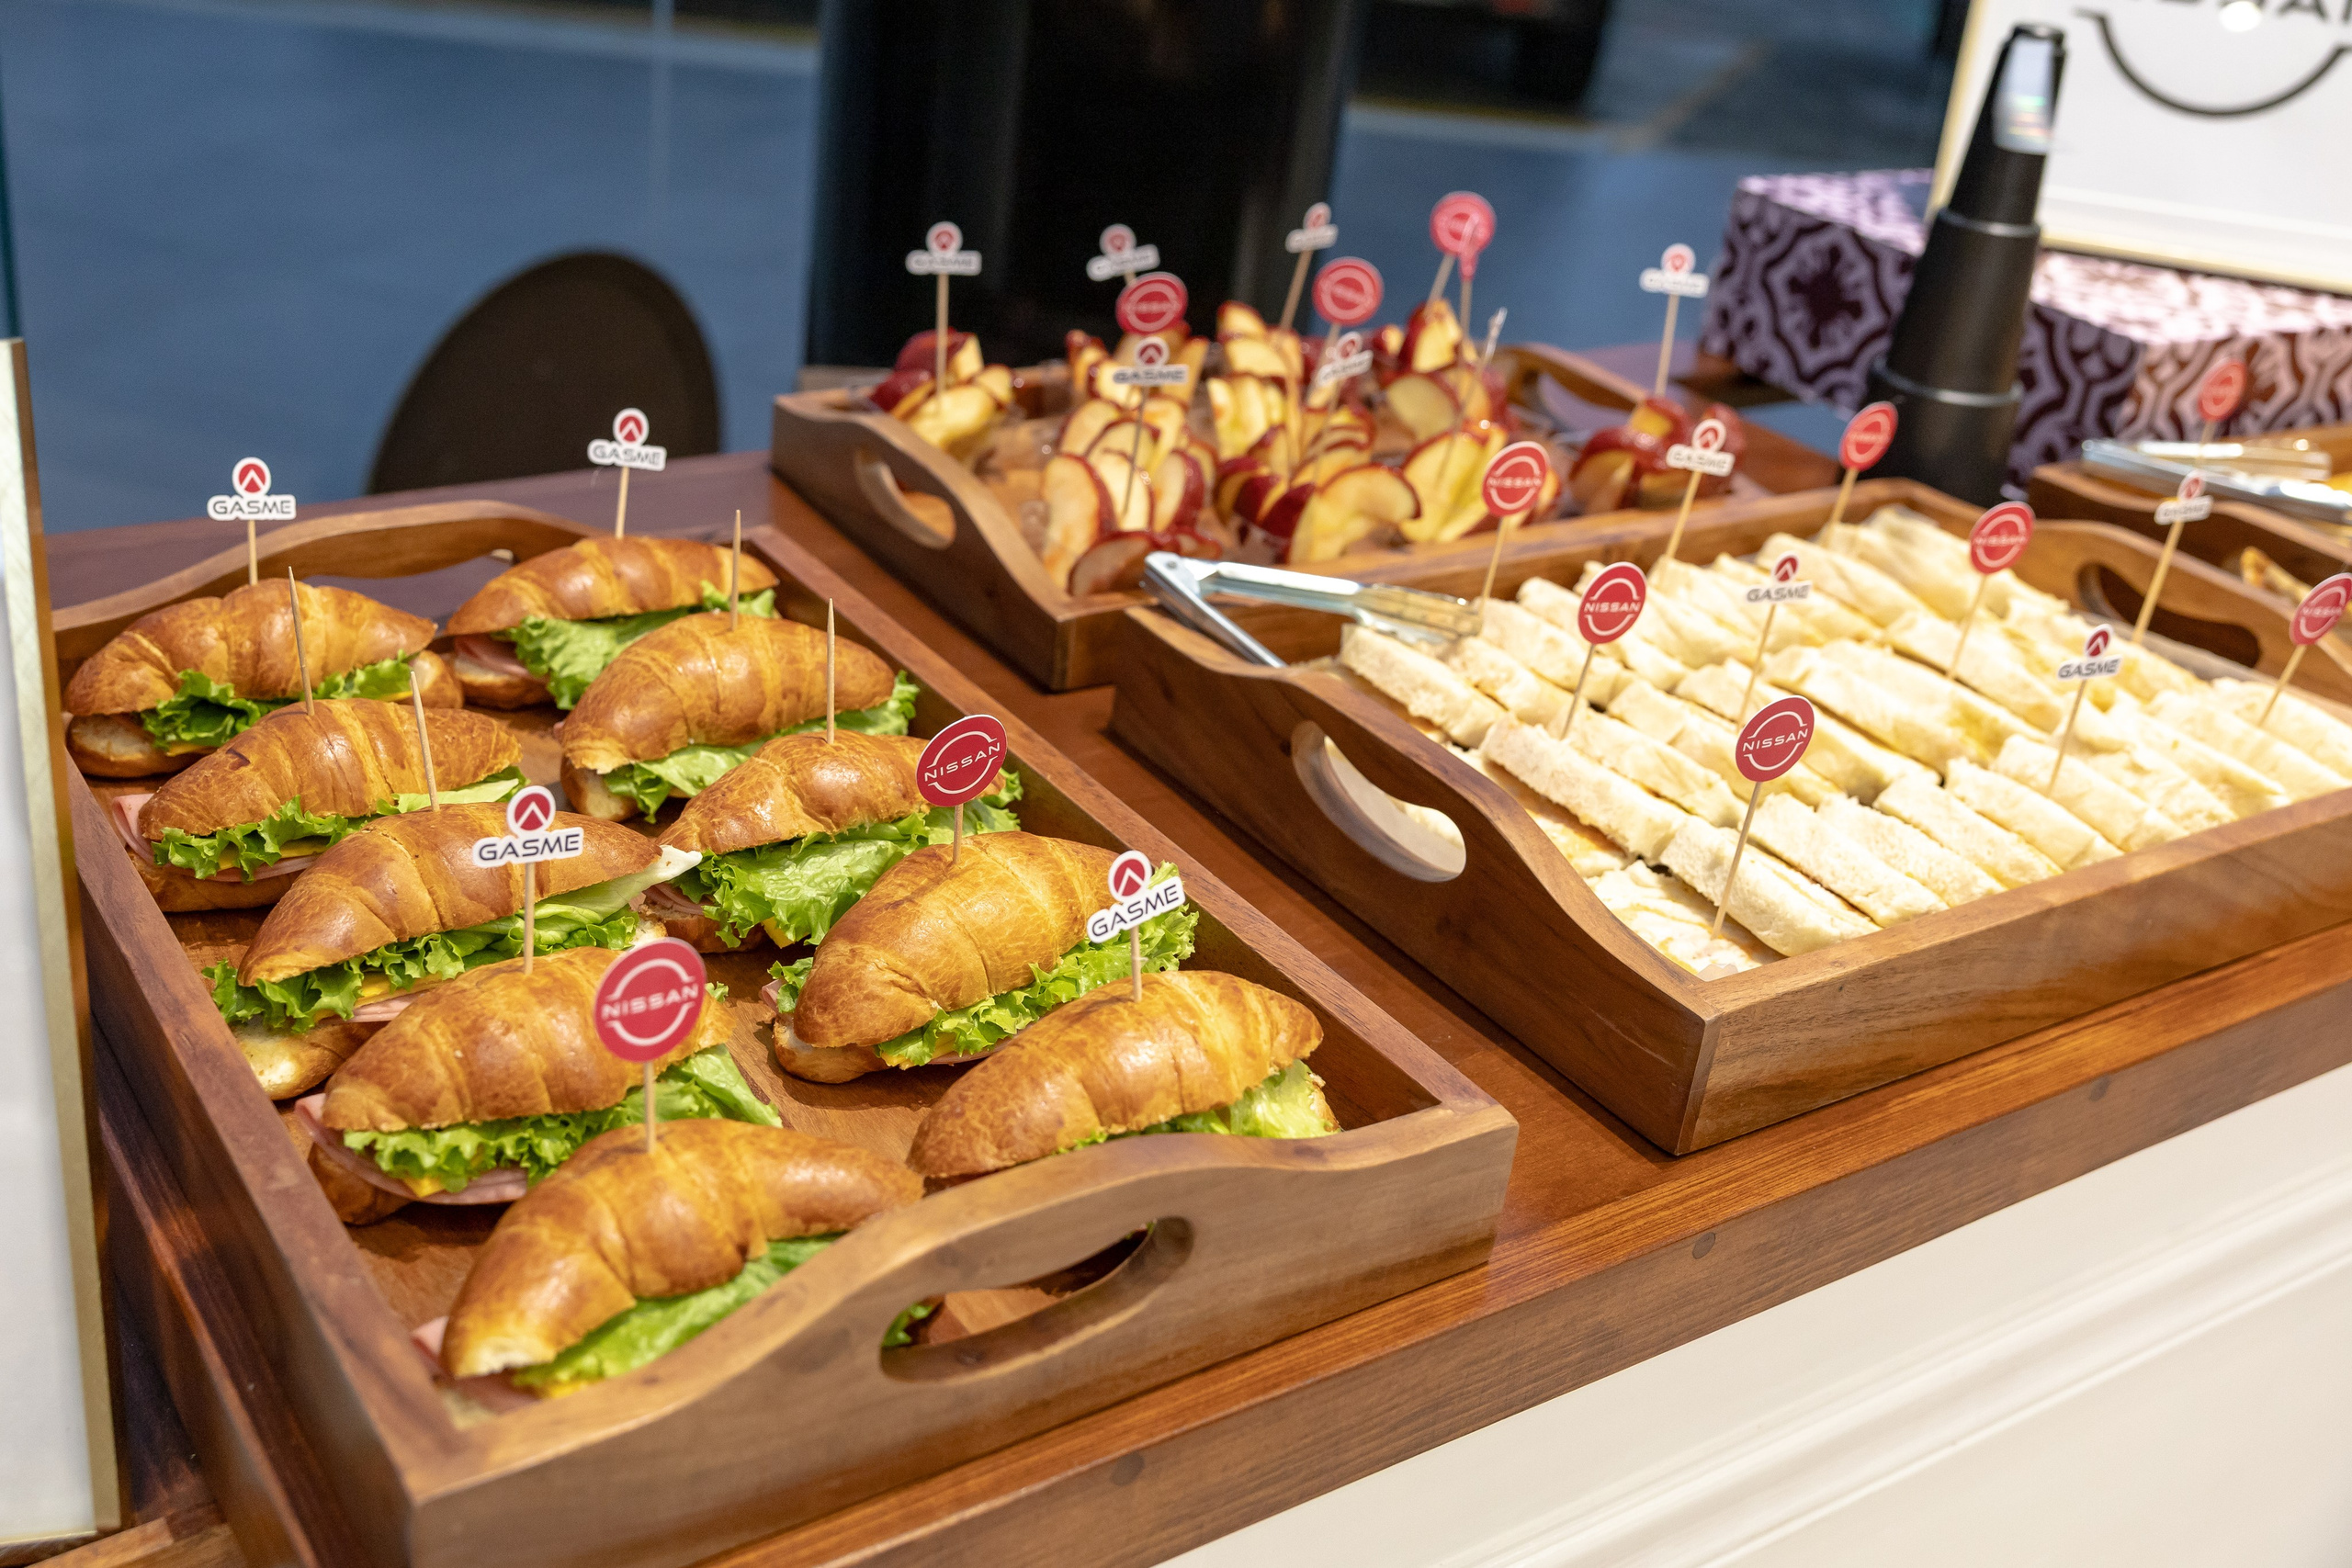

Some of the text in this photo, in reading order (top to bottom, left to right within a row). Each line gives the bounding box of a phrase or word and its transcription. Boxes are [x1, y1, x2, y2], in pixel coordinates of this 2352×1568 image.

[593, 445, 661, 465] GASME
[212, 500, 291, 514] GASME
[1747, 586, 1810, 603] GASME
[1584, 602, 1640, 613] NISSAN
[2059, 660, 2119, 678] GASME
[1743, 728, 1808, 751] NISSAN
[925, 743, 1001, 781] NISSAN
[479, 834, 580, 861] GASME
[1092, 885, 1180, 937] GASME
[602, 984, 698, 1017] NISSAN
